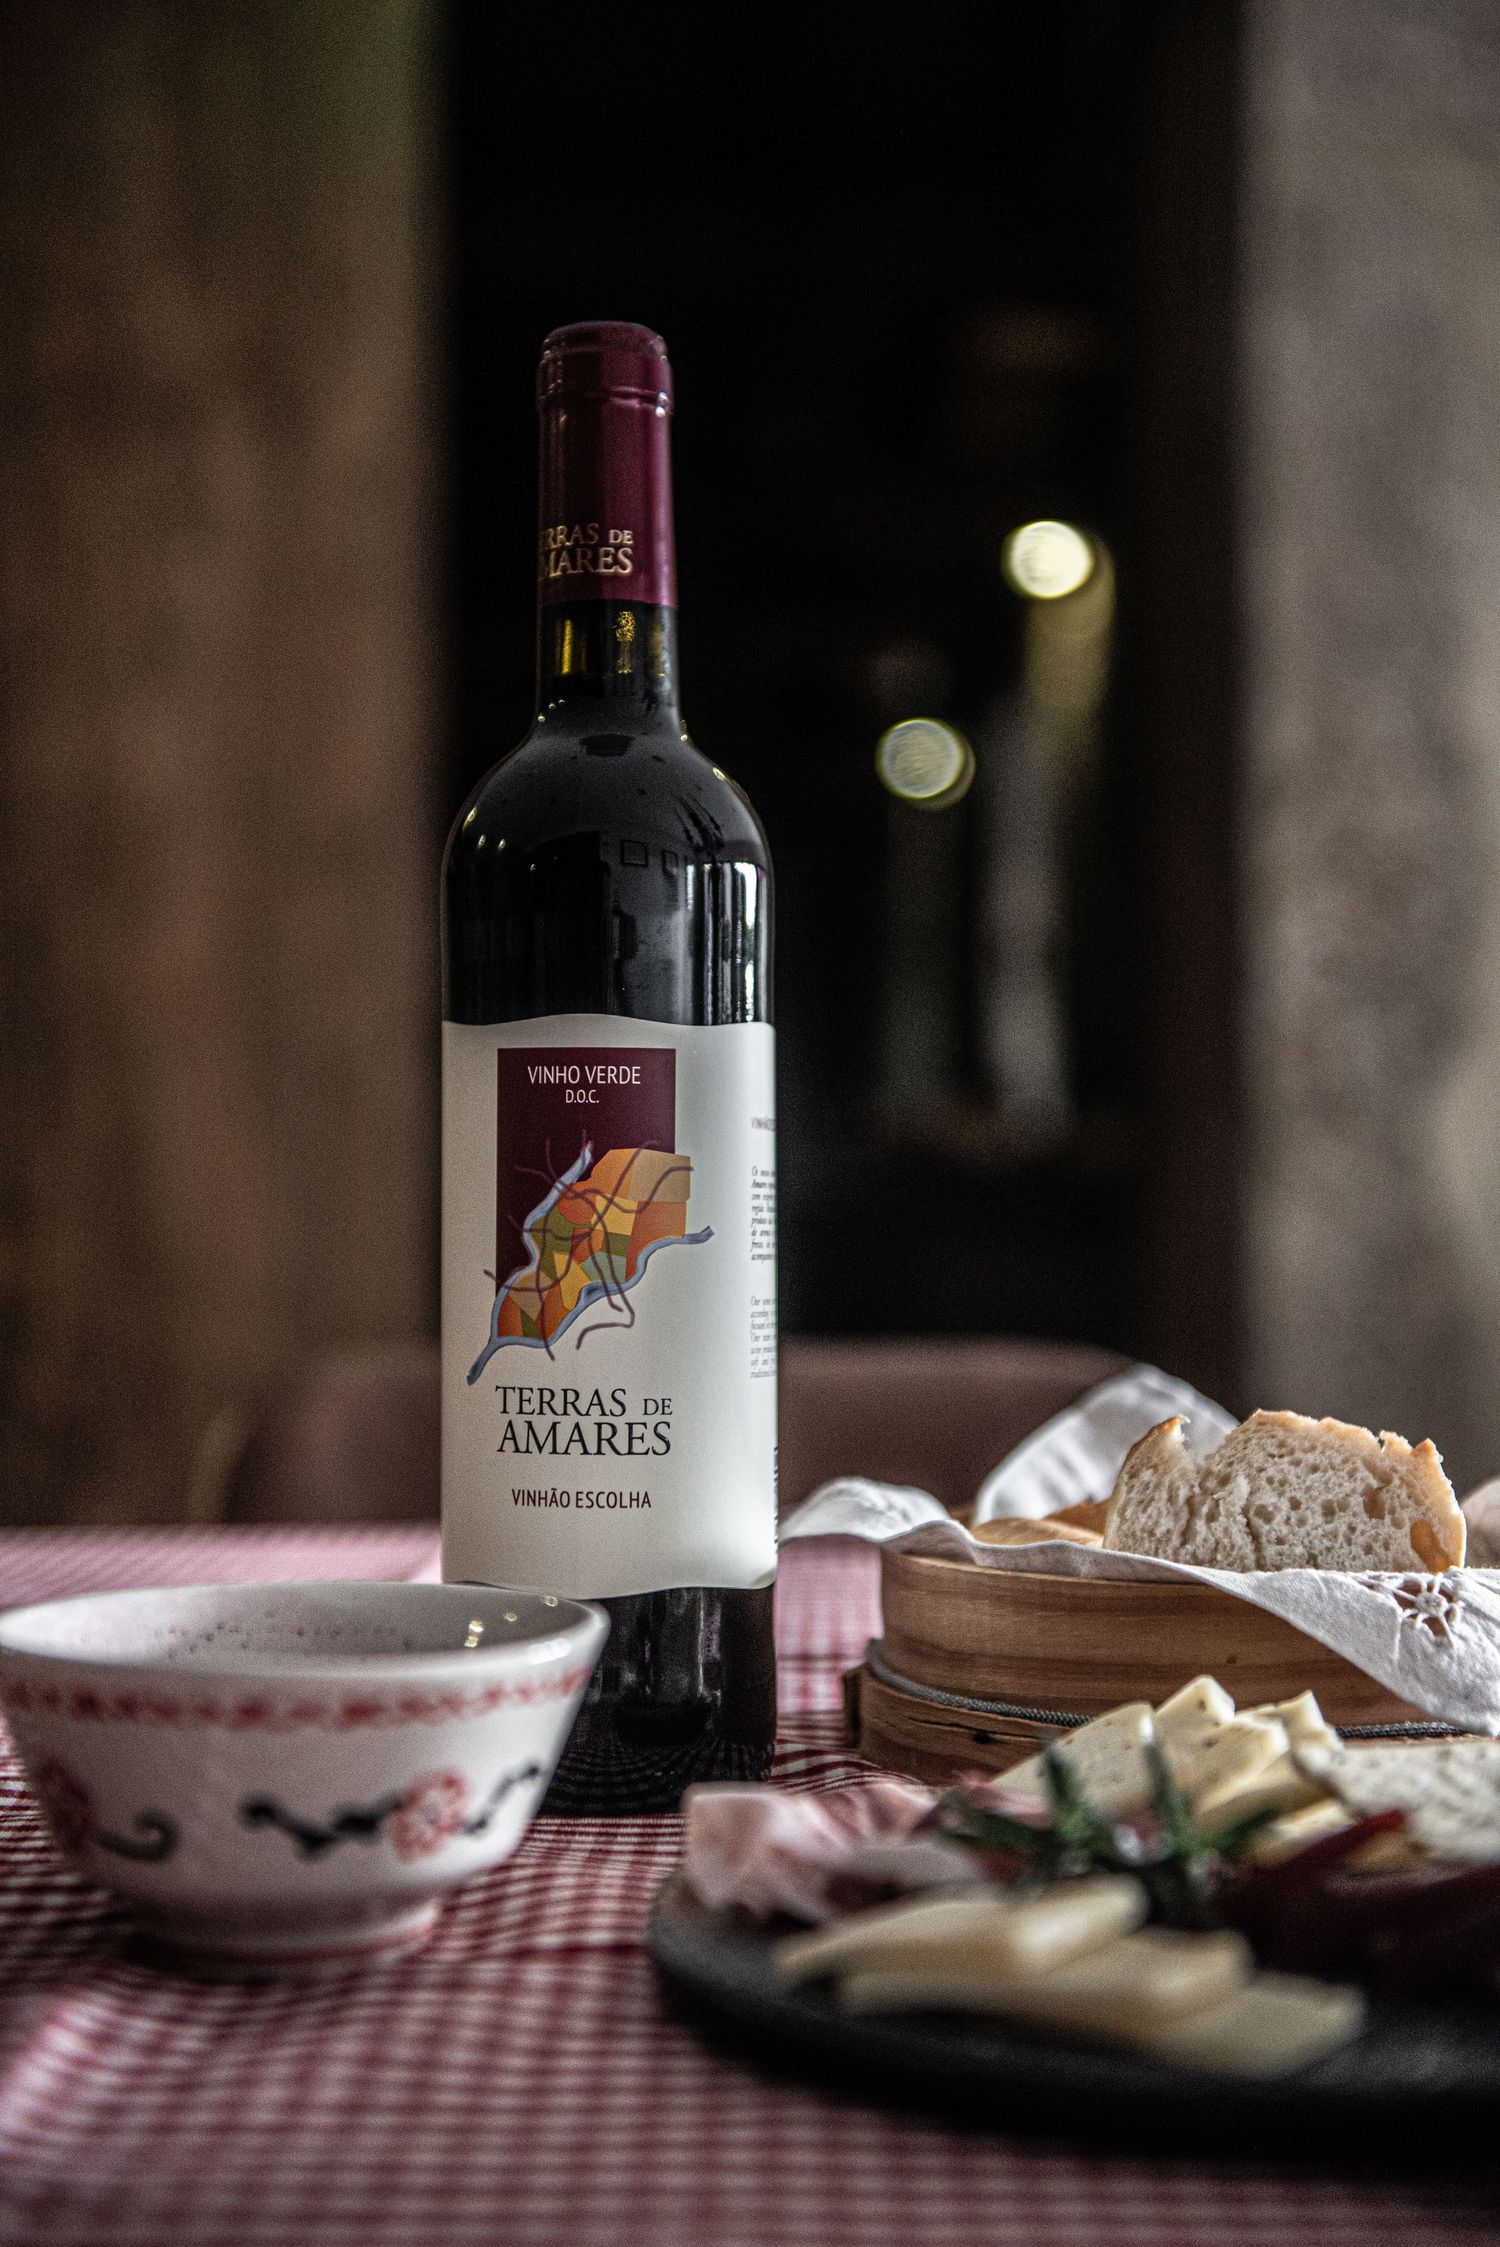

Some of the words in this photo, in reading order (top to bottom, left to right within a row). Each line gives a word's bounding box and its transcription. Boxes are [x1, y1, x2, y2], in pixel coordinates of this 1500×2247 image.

[608, 529, 634, 544] DE
[527, 1065, 581, 1085] VINHO
[585, 1065, 641, 1085] VERDE
[565, 1089, 600, 1104] D.O.C.
[495, 1385, 627, 1417] TERRAS
[642, 1397, 673, 1416] DE
[496, 1419, 671, 1456] AMARES
[511, 1487, 570, 1508] VINHÃO
[575, 1490, 652, 1509] ESCOLHA
